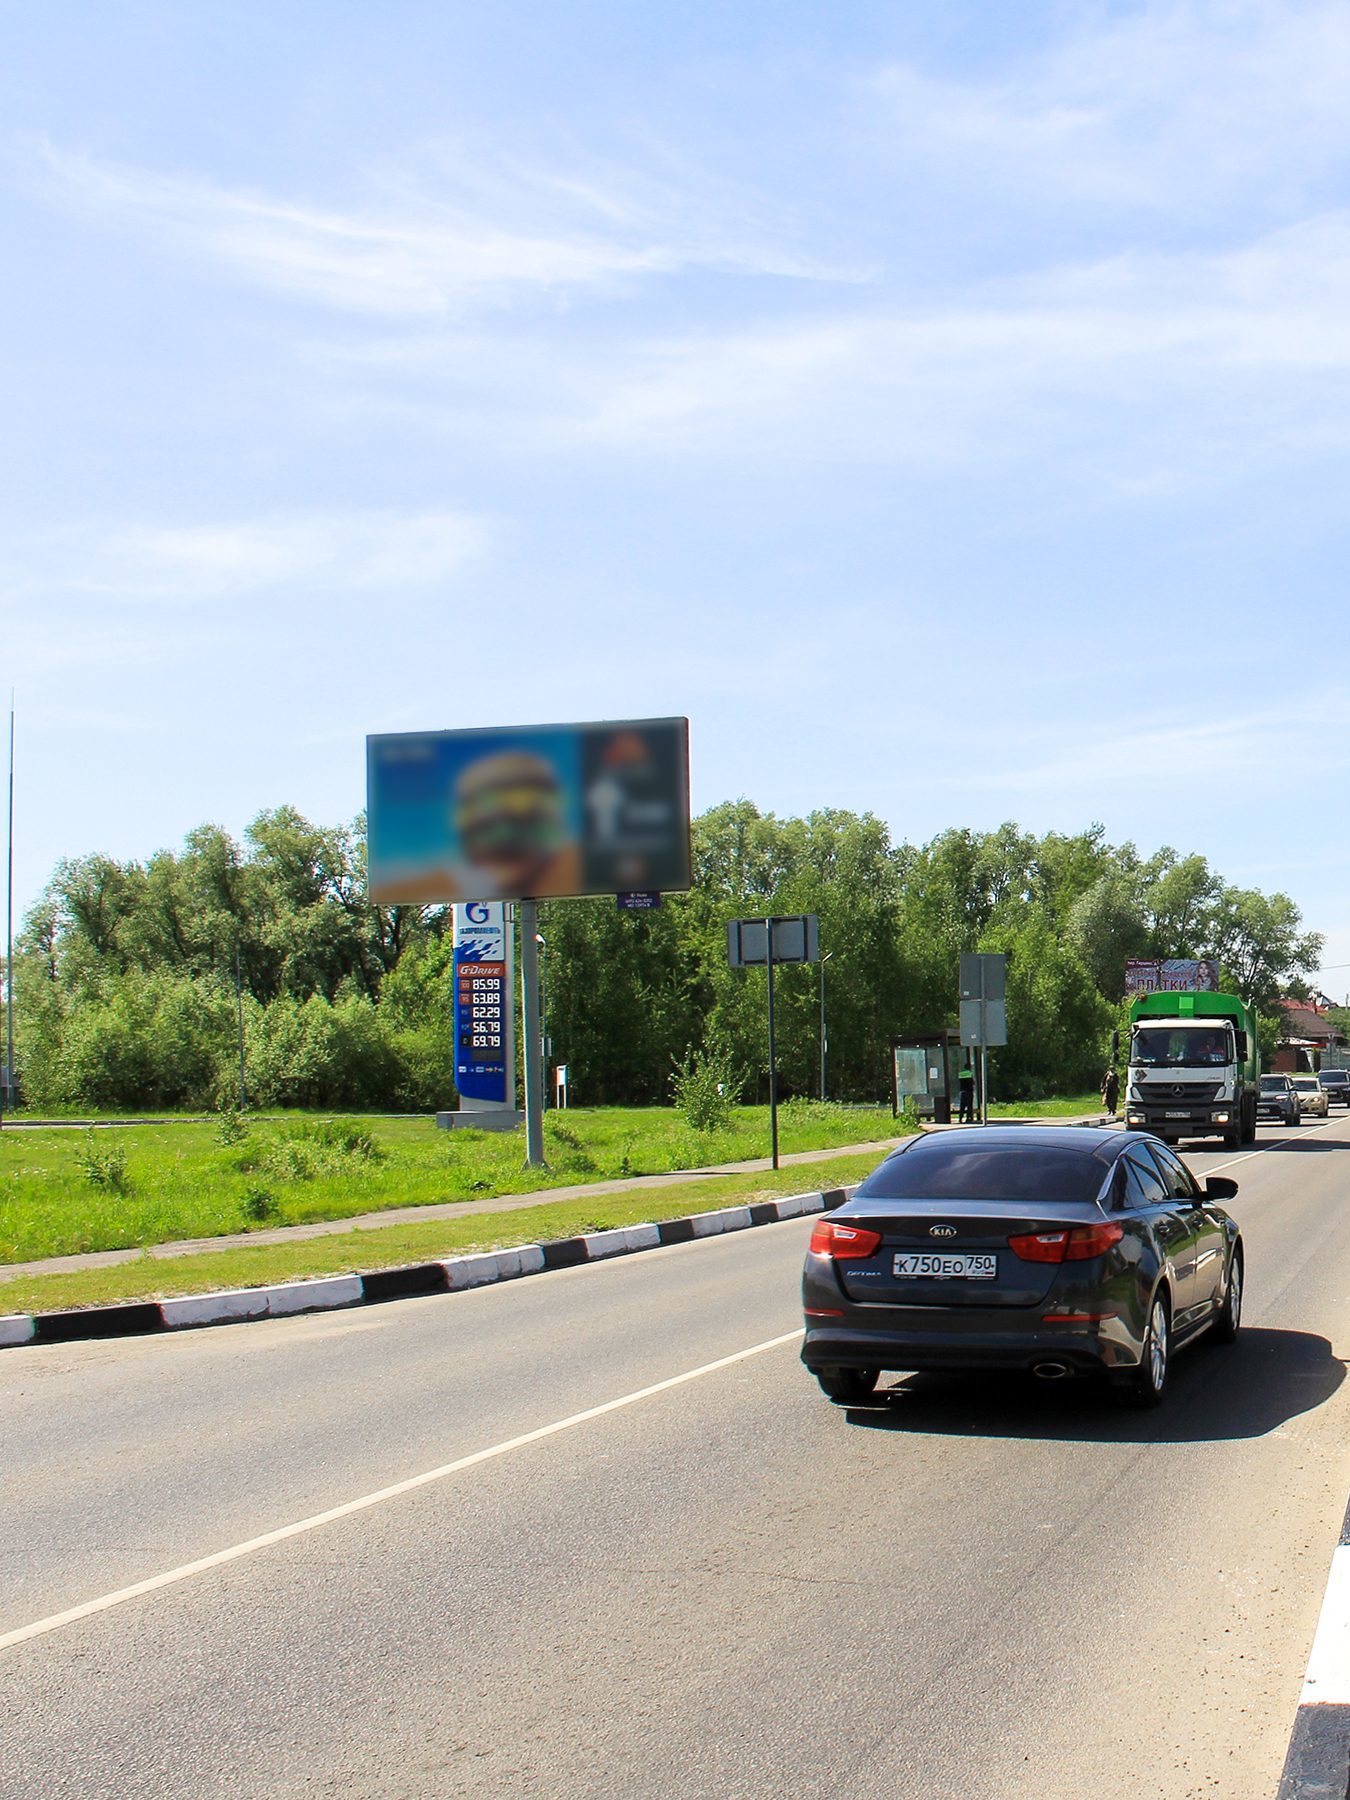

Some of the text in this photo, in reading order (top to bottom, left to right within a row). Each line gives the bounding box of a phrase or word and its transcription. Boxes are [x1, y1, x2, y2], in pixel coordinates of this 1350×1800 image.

[472, 979, 500, 990] 85.99
[1137, 979, 1187, 991] ПЛТКИ
[472, 993, 500, 1004] 63.89
[472, 1007, 500, 1018] 62.29
[472, 1021, 500, 1033] 56.79
[472, 1035, 500, 1047] 69.79
[934, 1228, 952, 1236] KIA
